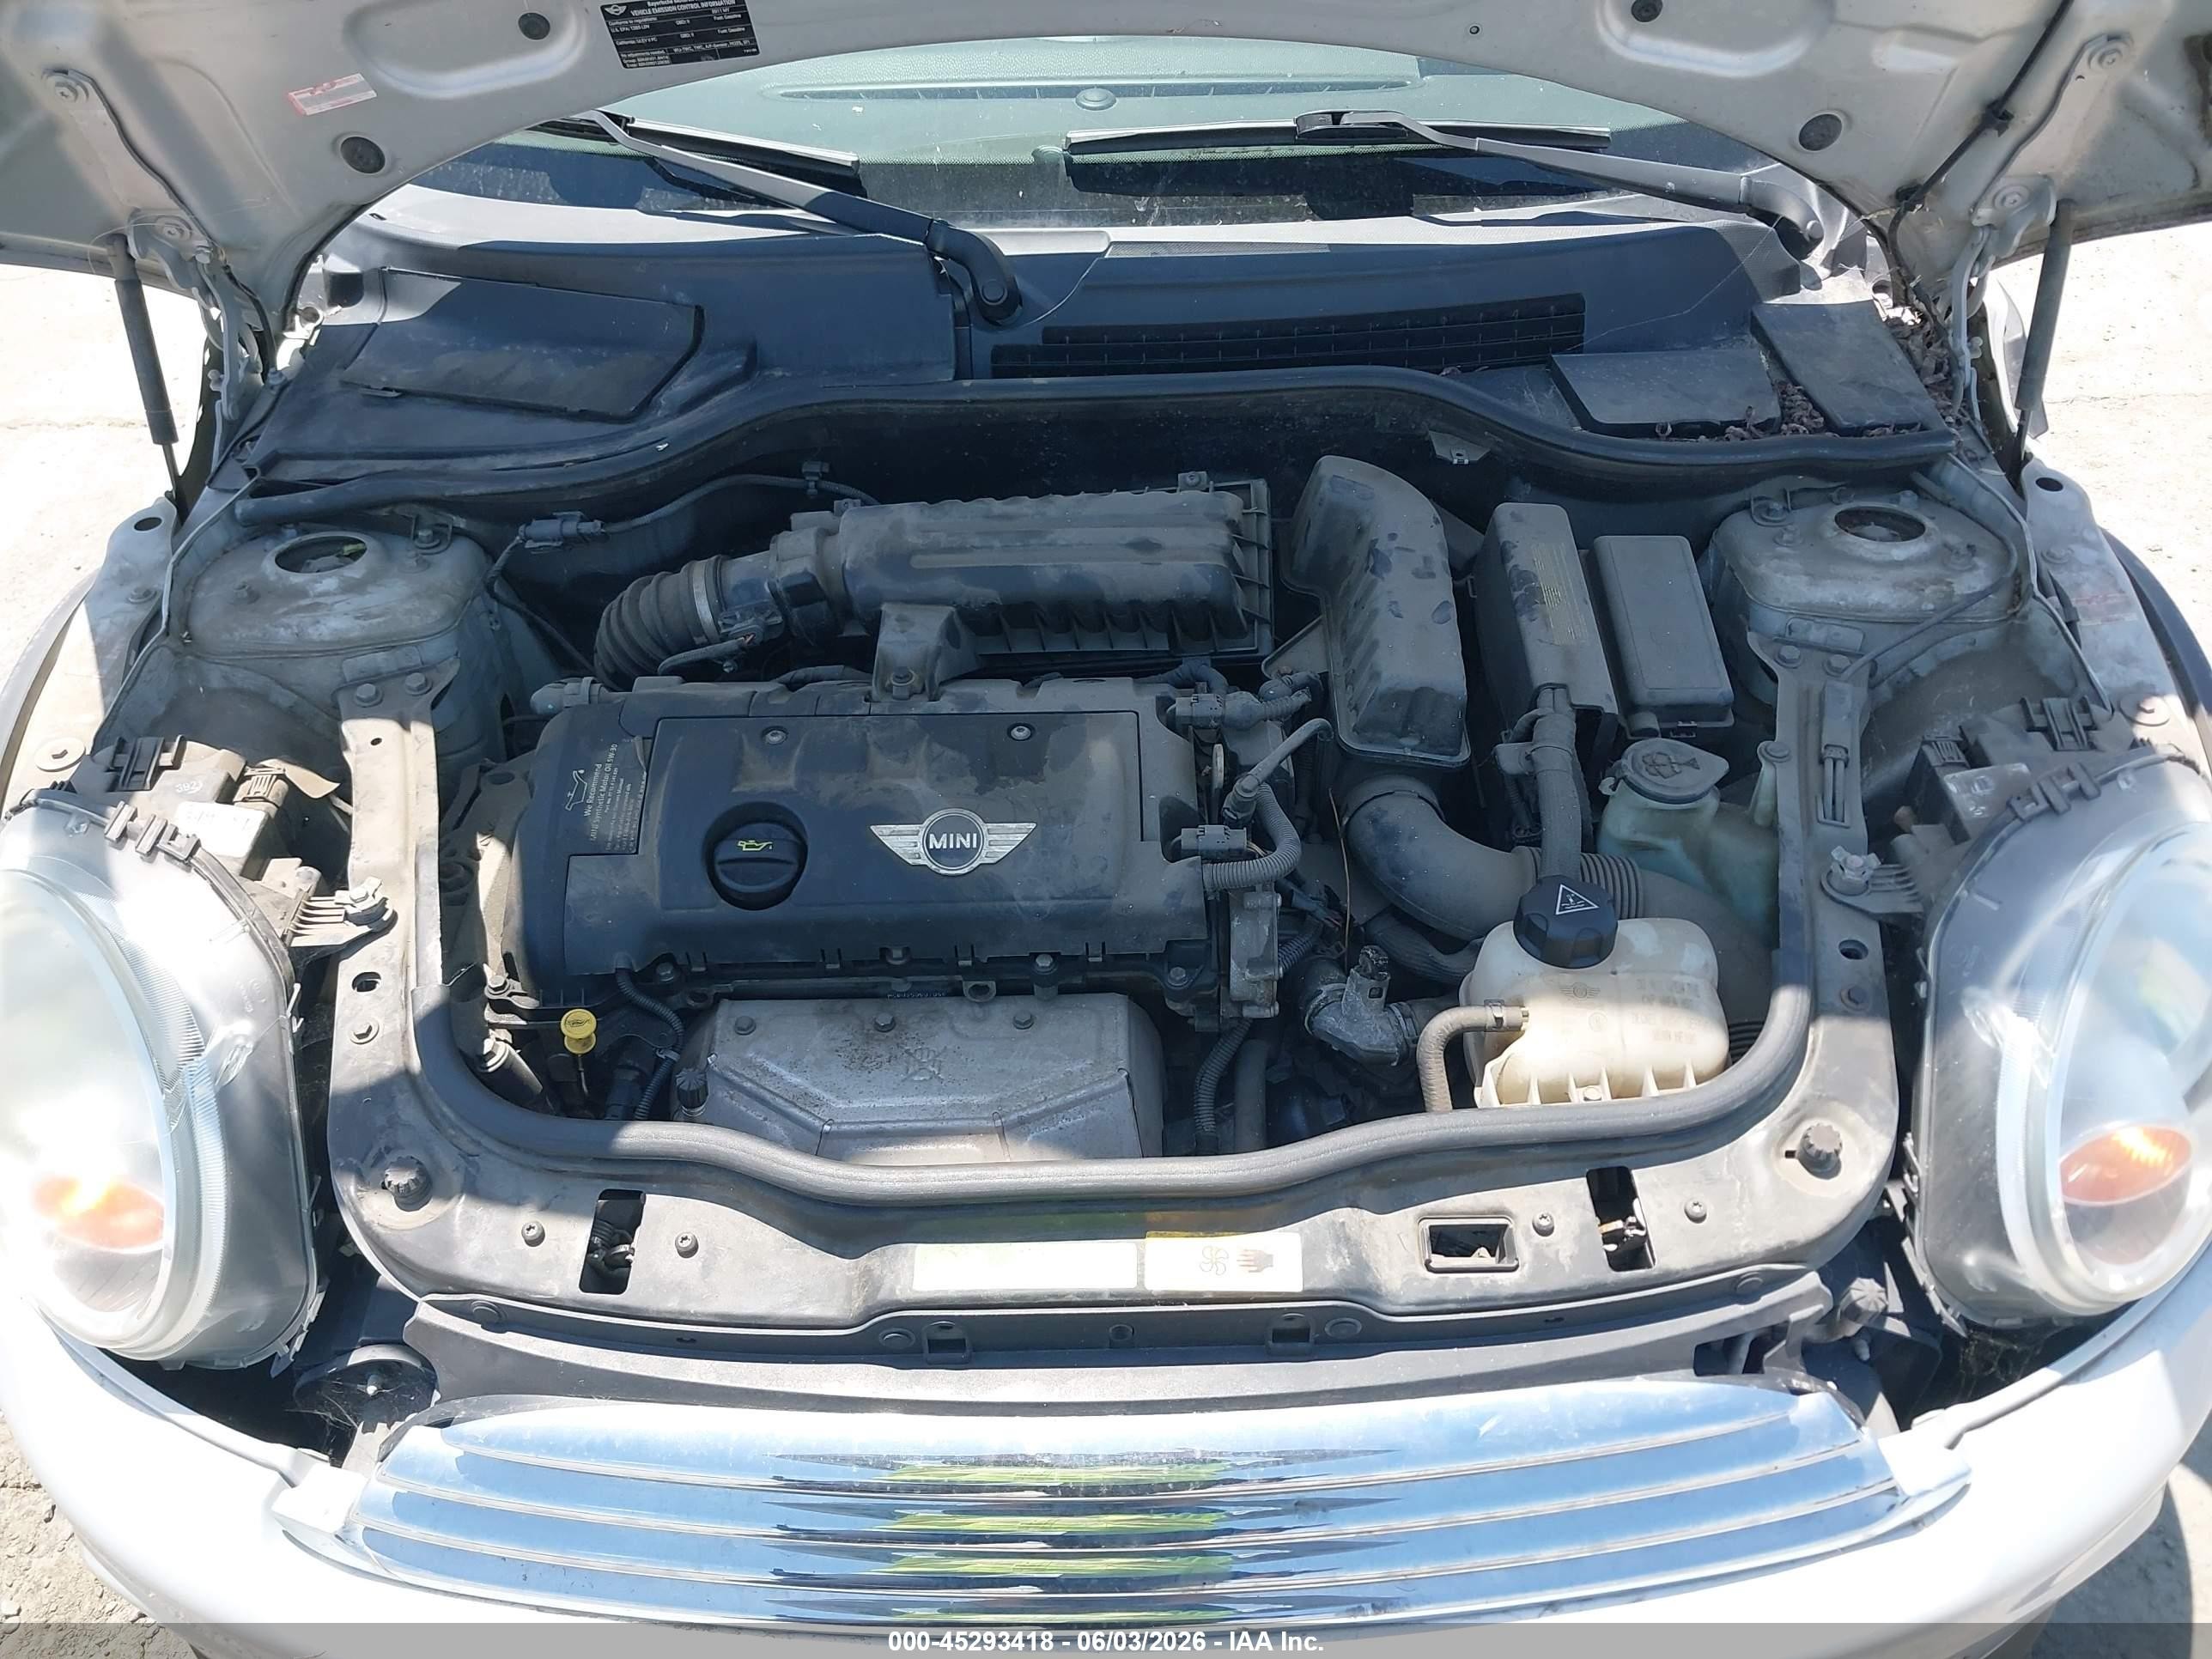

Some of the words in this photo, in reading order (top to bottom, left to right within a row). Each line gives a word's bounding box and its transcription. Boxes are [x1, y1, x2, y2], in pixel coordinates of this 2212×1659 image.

[653, 5, 677, 14] EMISSION
[677, 3, 701, 11] CONTROL
[606, 744, 618, 763] 5W-30
[604, 763, 612, 772] Oil
[586, 763, 603, 804] Recommend
[599, 773, 610, 792] Motor
[584, 805, 592, 817] We
[592, 792, 606, 823] Synthetic
[929, 833, 977, 849] MINI
